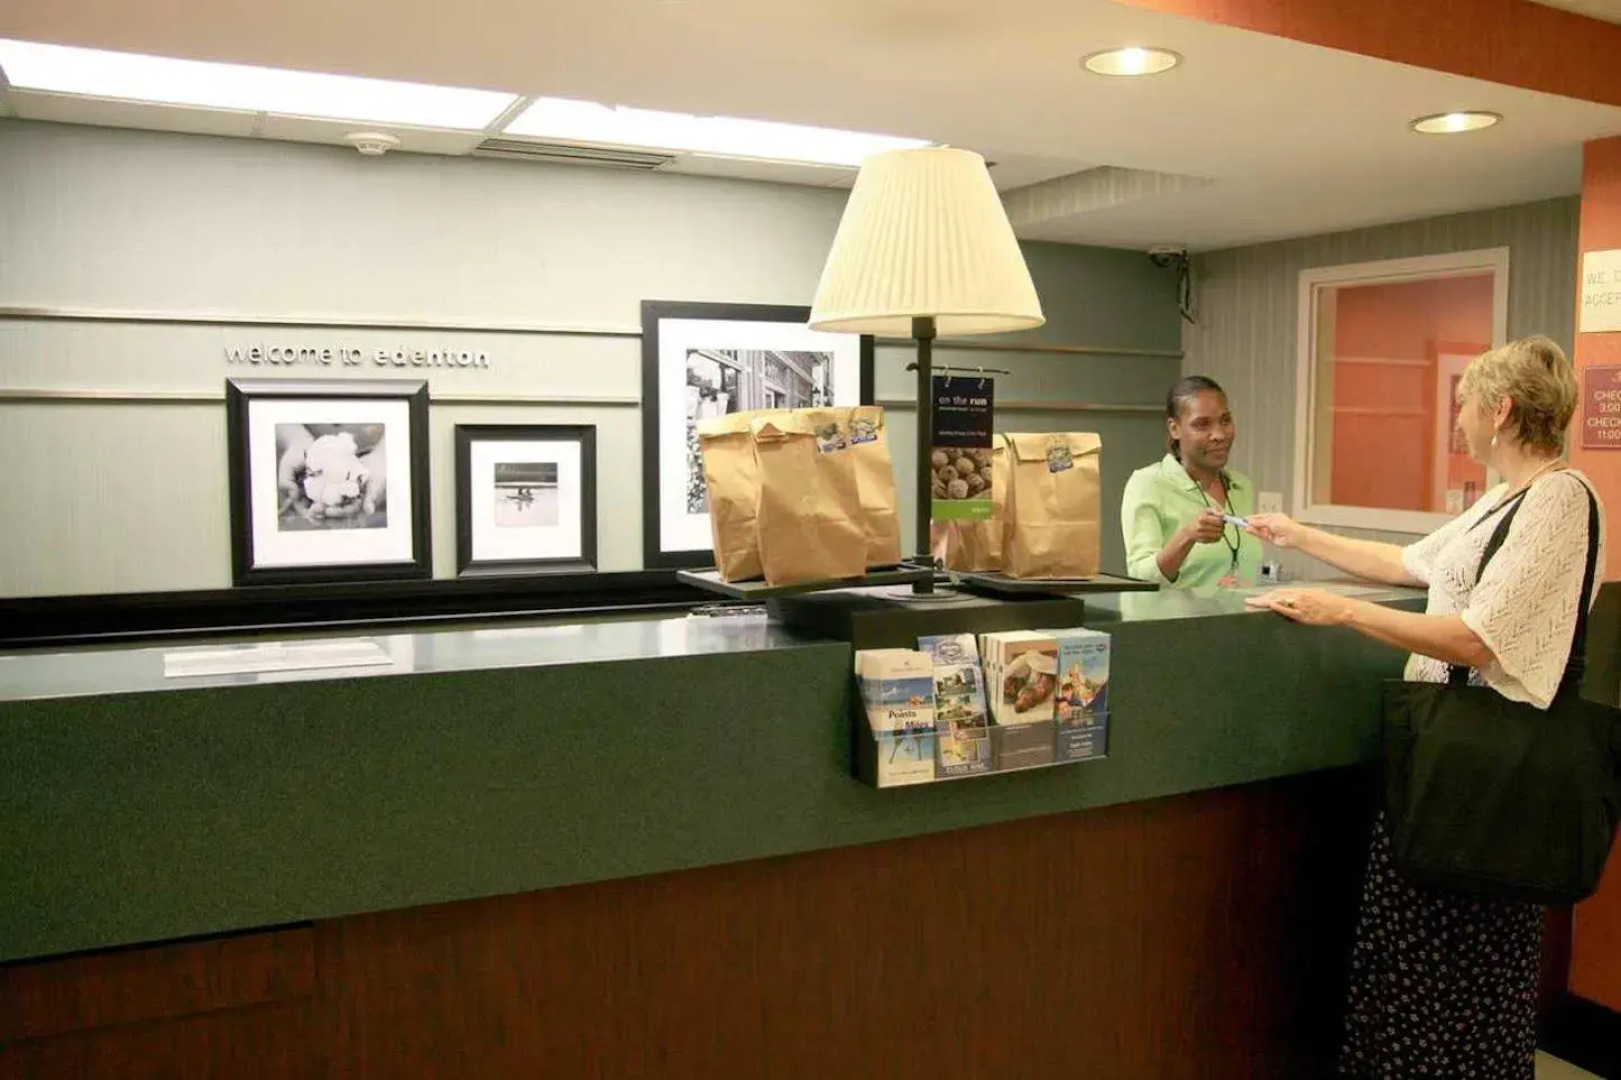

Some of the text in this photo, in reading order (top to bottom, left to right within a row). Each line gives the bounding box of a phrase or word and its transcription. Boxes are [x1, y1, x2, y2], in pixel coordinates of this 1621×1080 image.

[224, 342, 490, 368] welcome to edenton
[938, 395, 988, 406] on the run
[888, 709, 918, 719] Points
